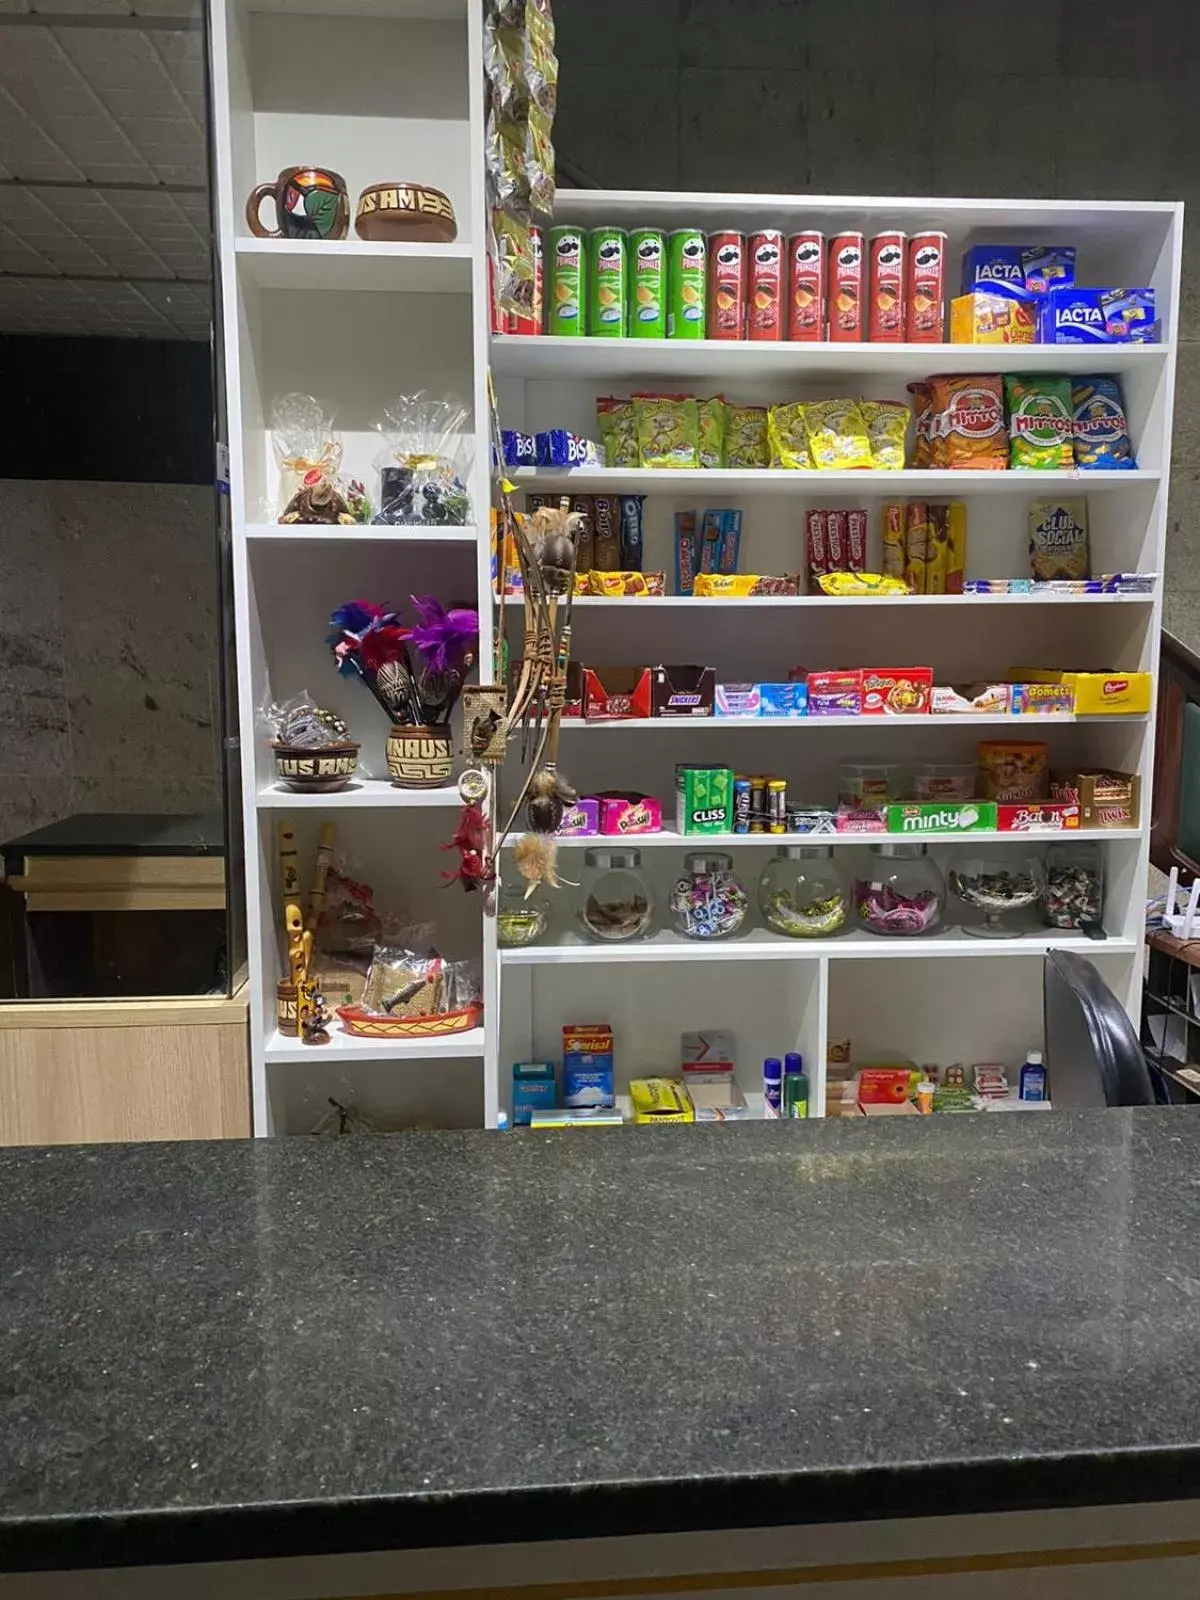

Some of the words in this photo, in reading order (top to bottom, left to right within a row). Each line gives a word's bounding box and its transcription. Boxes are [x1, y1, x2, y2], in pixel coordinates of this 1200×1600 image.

[976, 265, 1022, 282] LACTA
[1056, 308, 1102, 326] LACTA
[1016, 415, 1072, 434] MITTOS
[693, 809, 725, 822] CLISS
[903, 811, 960, 831] minty
